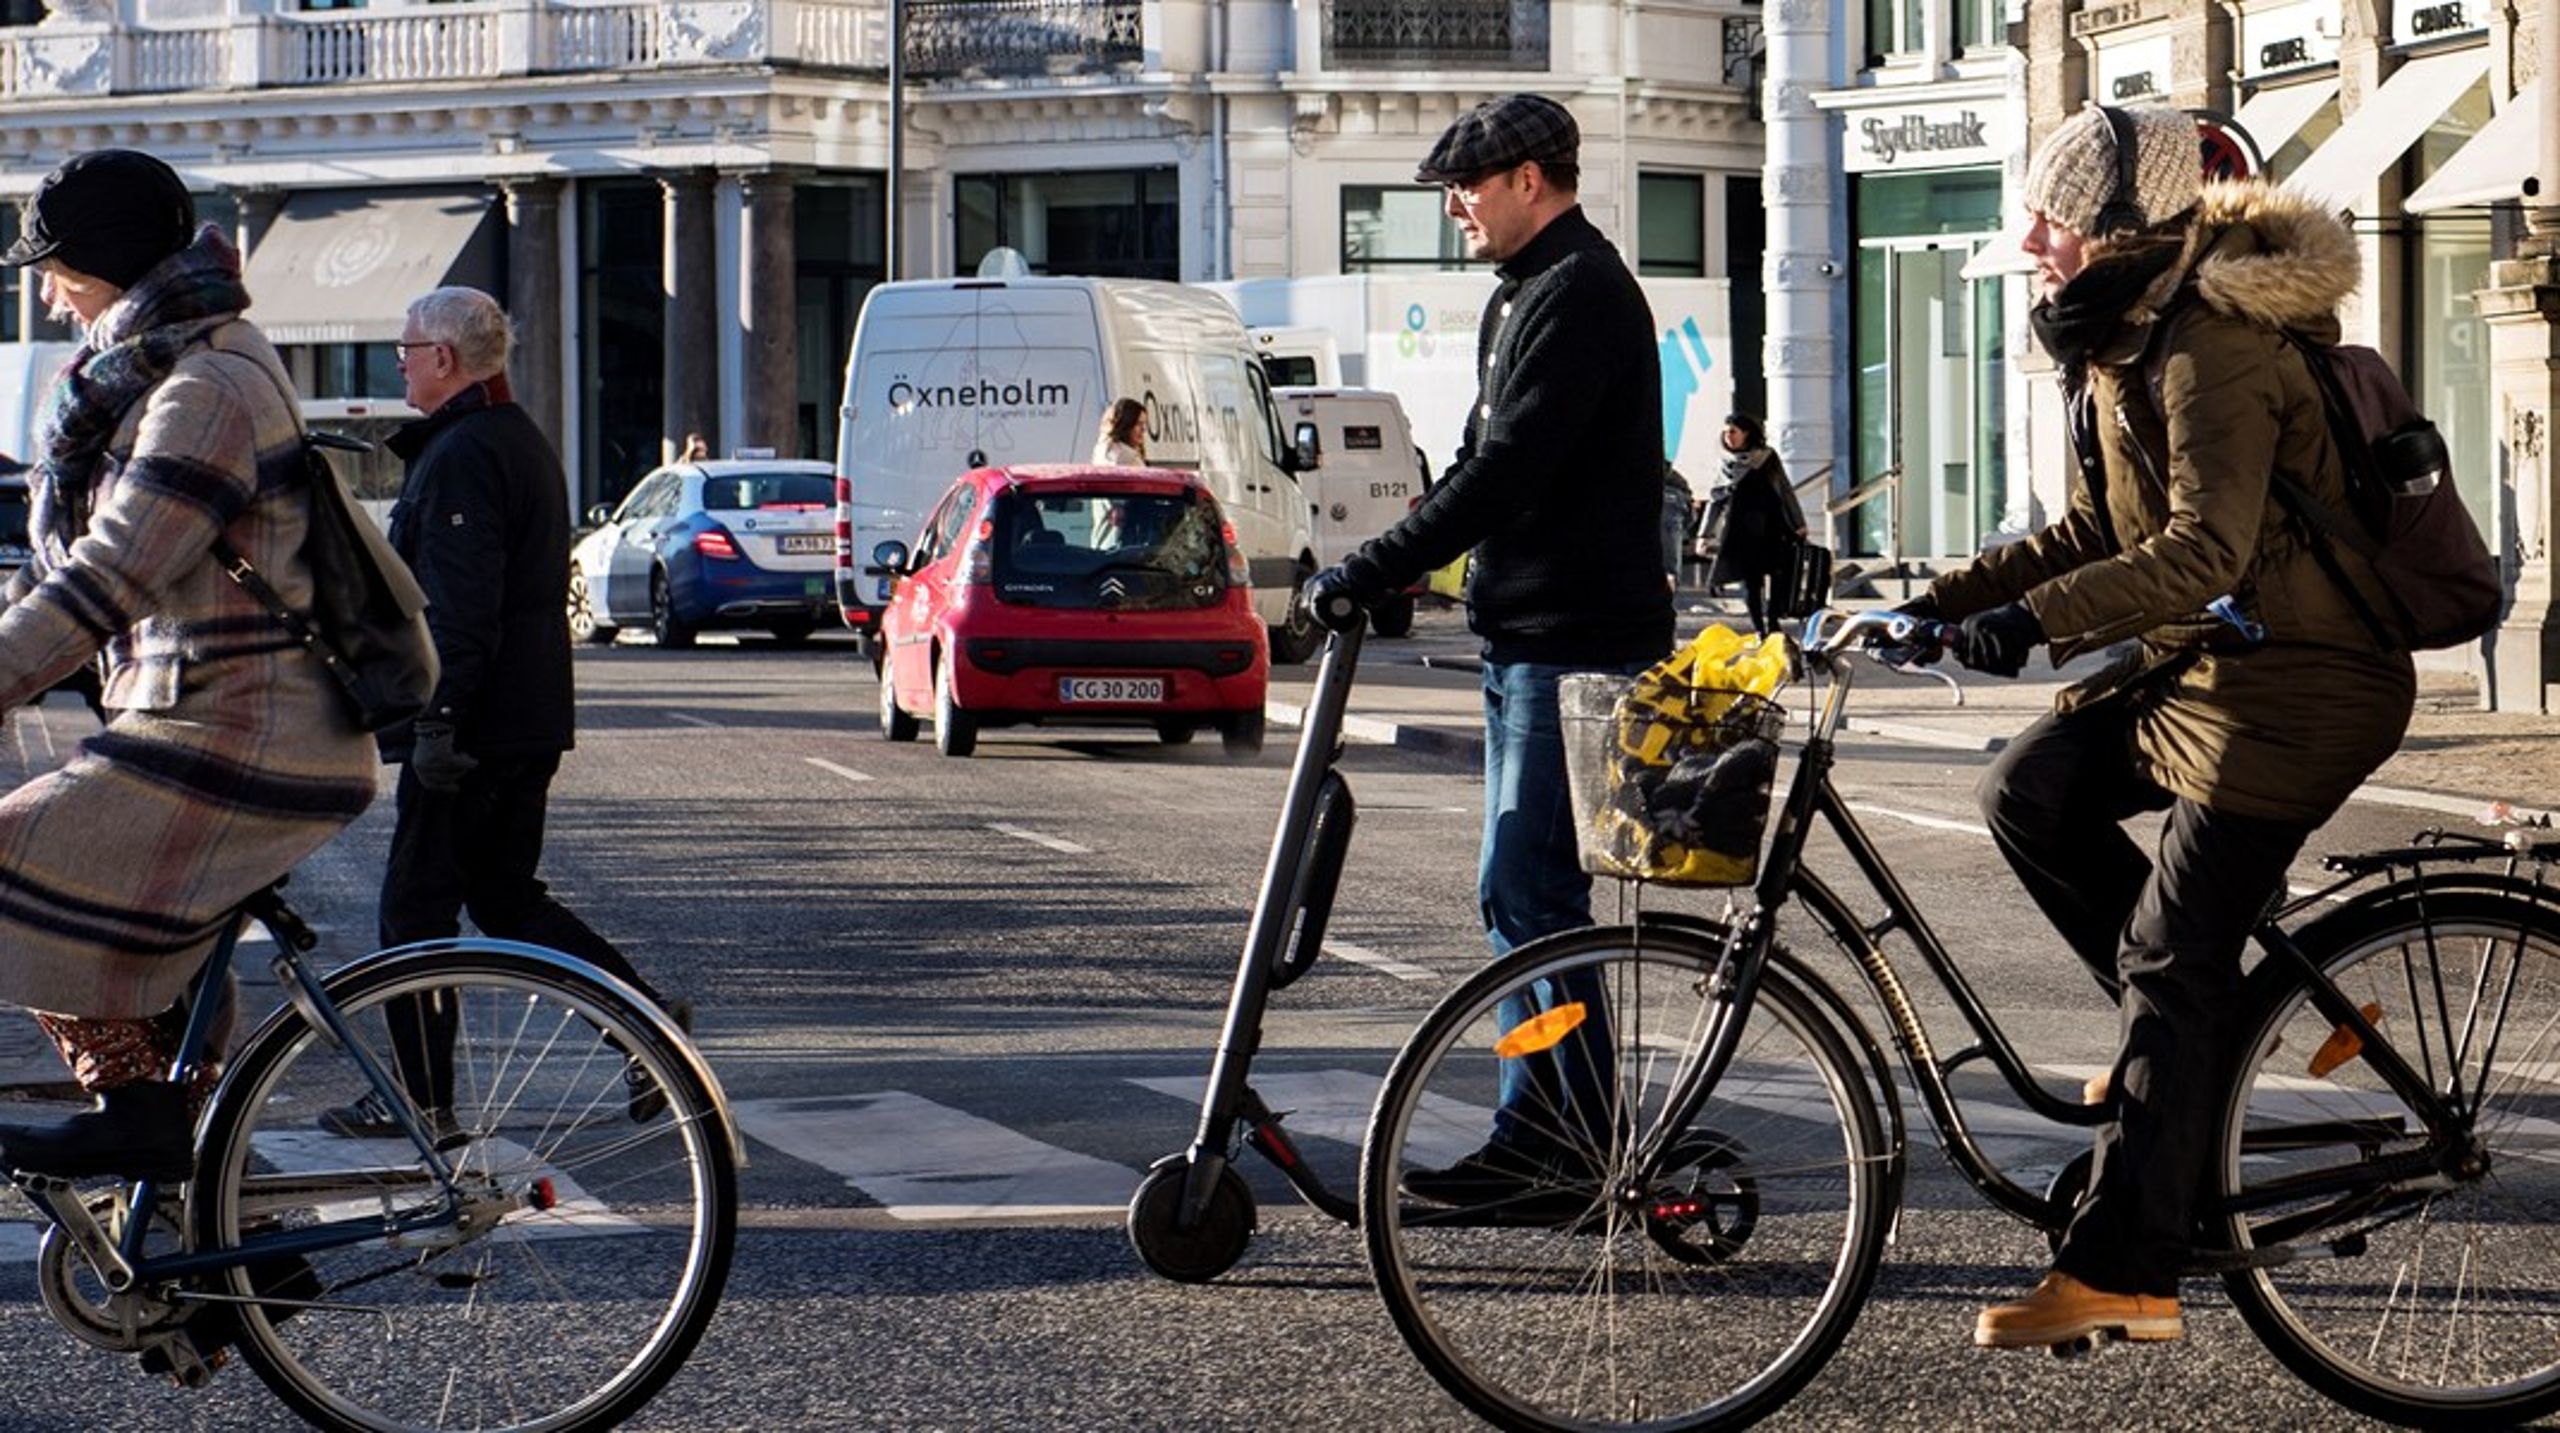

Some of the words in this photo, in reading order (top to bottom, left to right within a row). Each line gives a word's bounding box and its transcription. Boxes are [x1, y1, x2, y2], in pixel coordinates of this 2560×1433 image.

[1860, 110, 1988, 164] Sydbank
[888, 374, 1069, 408] Öxneholm
[1370, 482, 1408, 498] B121
[1073, 681, 1098, 699] CG
[1101, 681, 1123, 699] 30
[1127, 681, 1161, 699] 200
